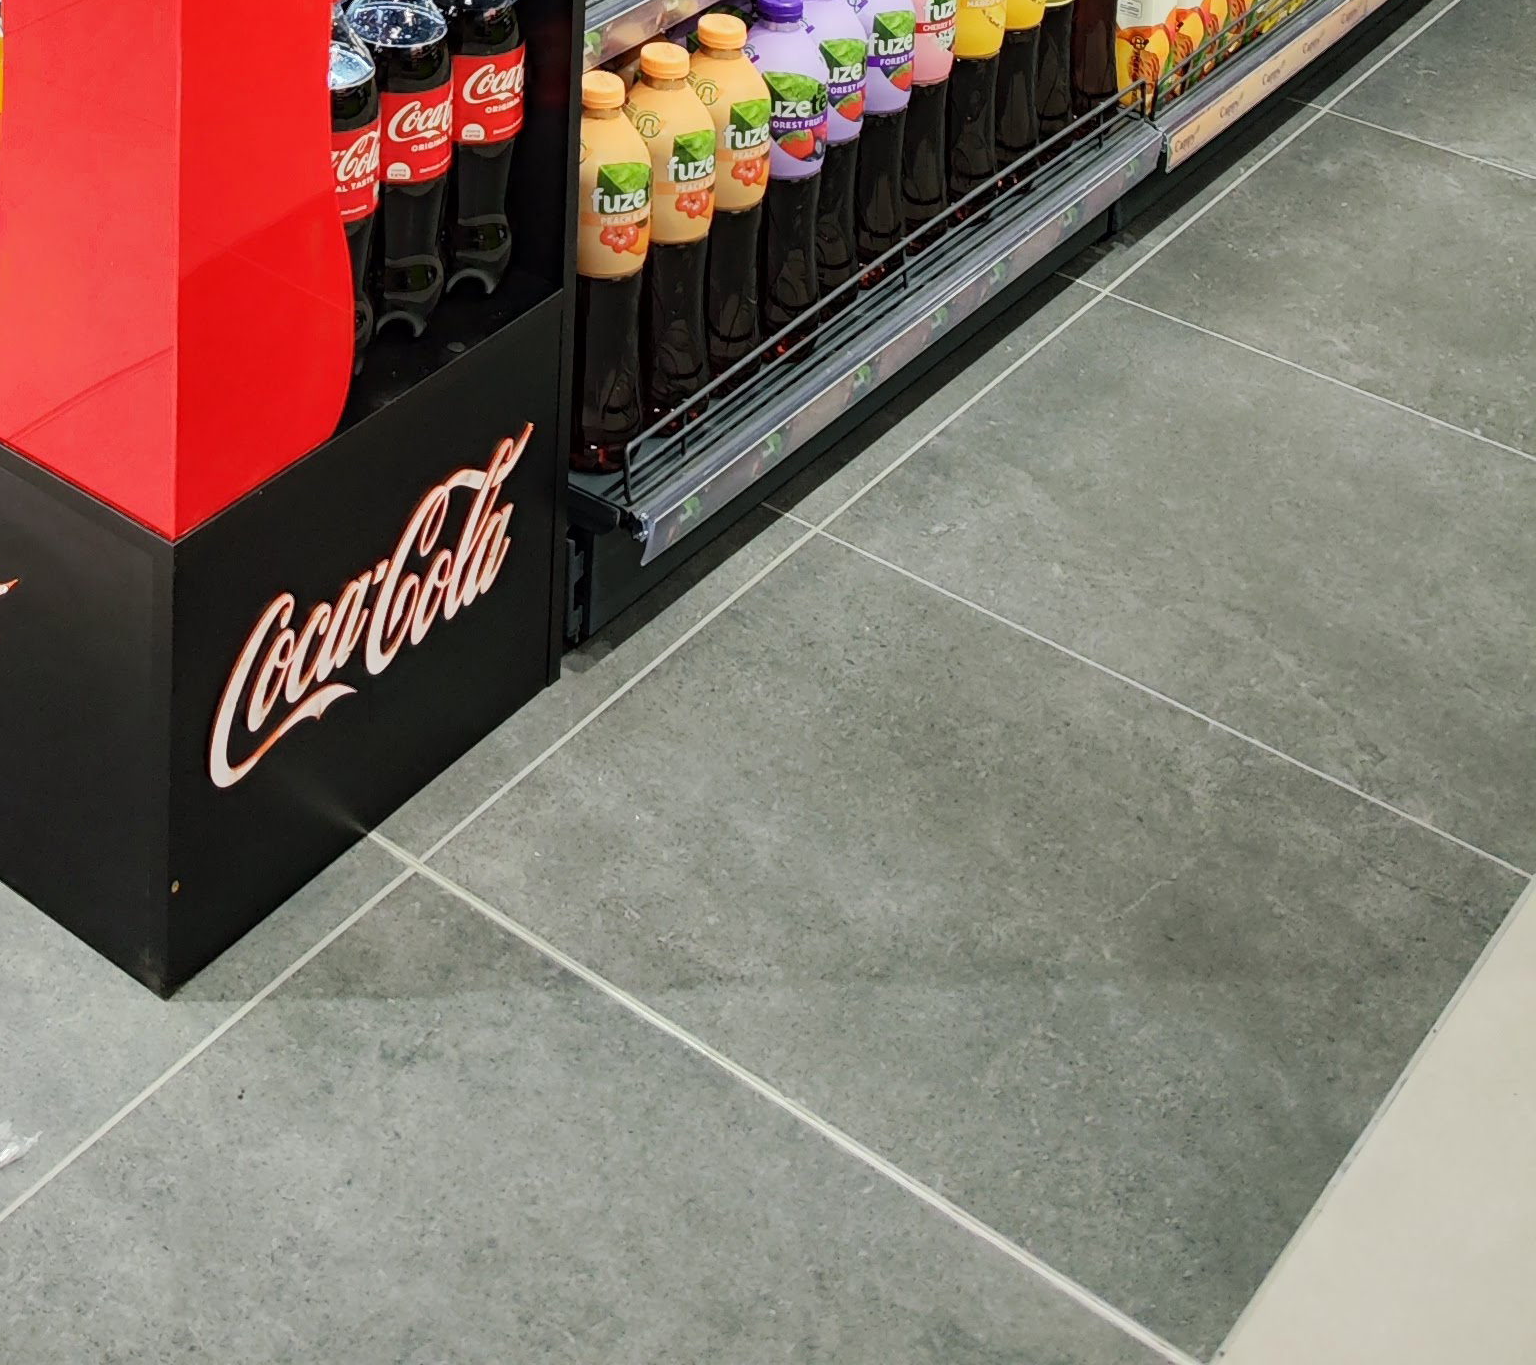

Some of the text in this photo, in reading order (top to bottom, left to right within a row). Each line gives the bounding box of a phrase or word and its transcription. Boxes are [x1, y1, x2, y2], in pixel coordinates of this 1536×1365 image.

[922, 21, 948, 32] CHERRY
[868, 32, 913, 56] fuze
[879, 55, 907, 67] FOREST
[827, 63, 863, 84] uze
[830, 83, 857, 95] OREST
[771, 99, 810, 118] uze
[772, 119, 803, 130] OREST
[723, 124, 770, 150] fuze
[666, 156, 715, 182] fuze
[675, 180, 704, 193] PEACH
[591, 187, 645, 215] fuze
[600, 212, 632, 225] PEACH
[208, 421, 534, 789] Coca-Cola
